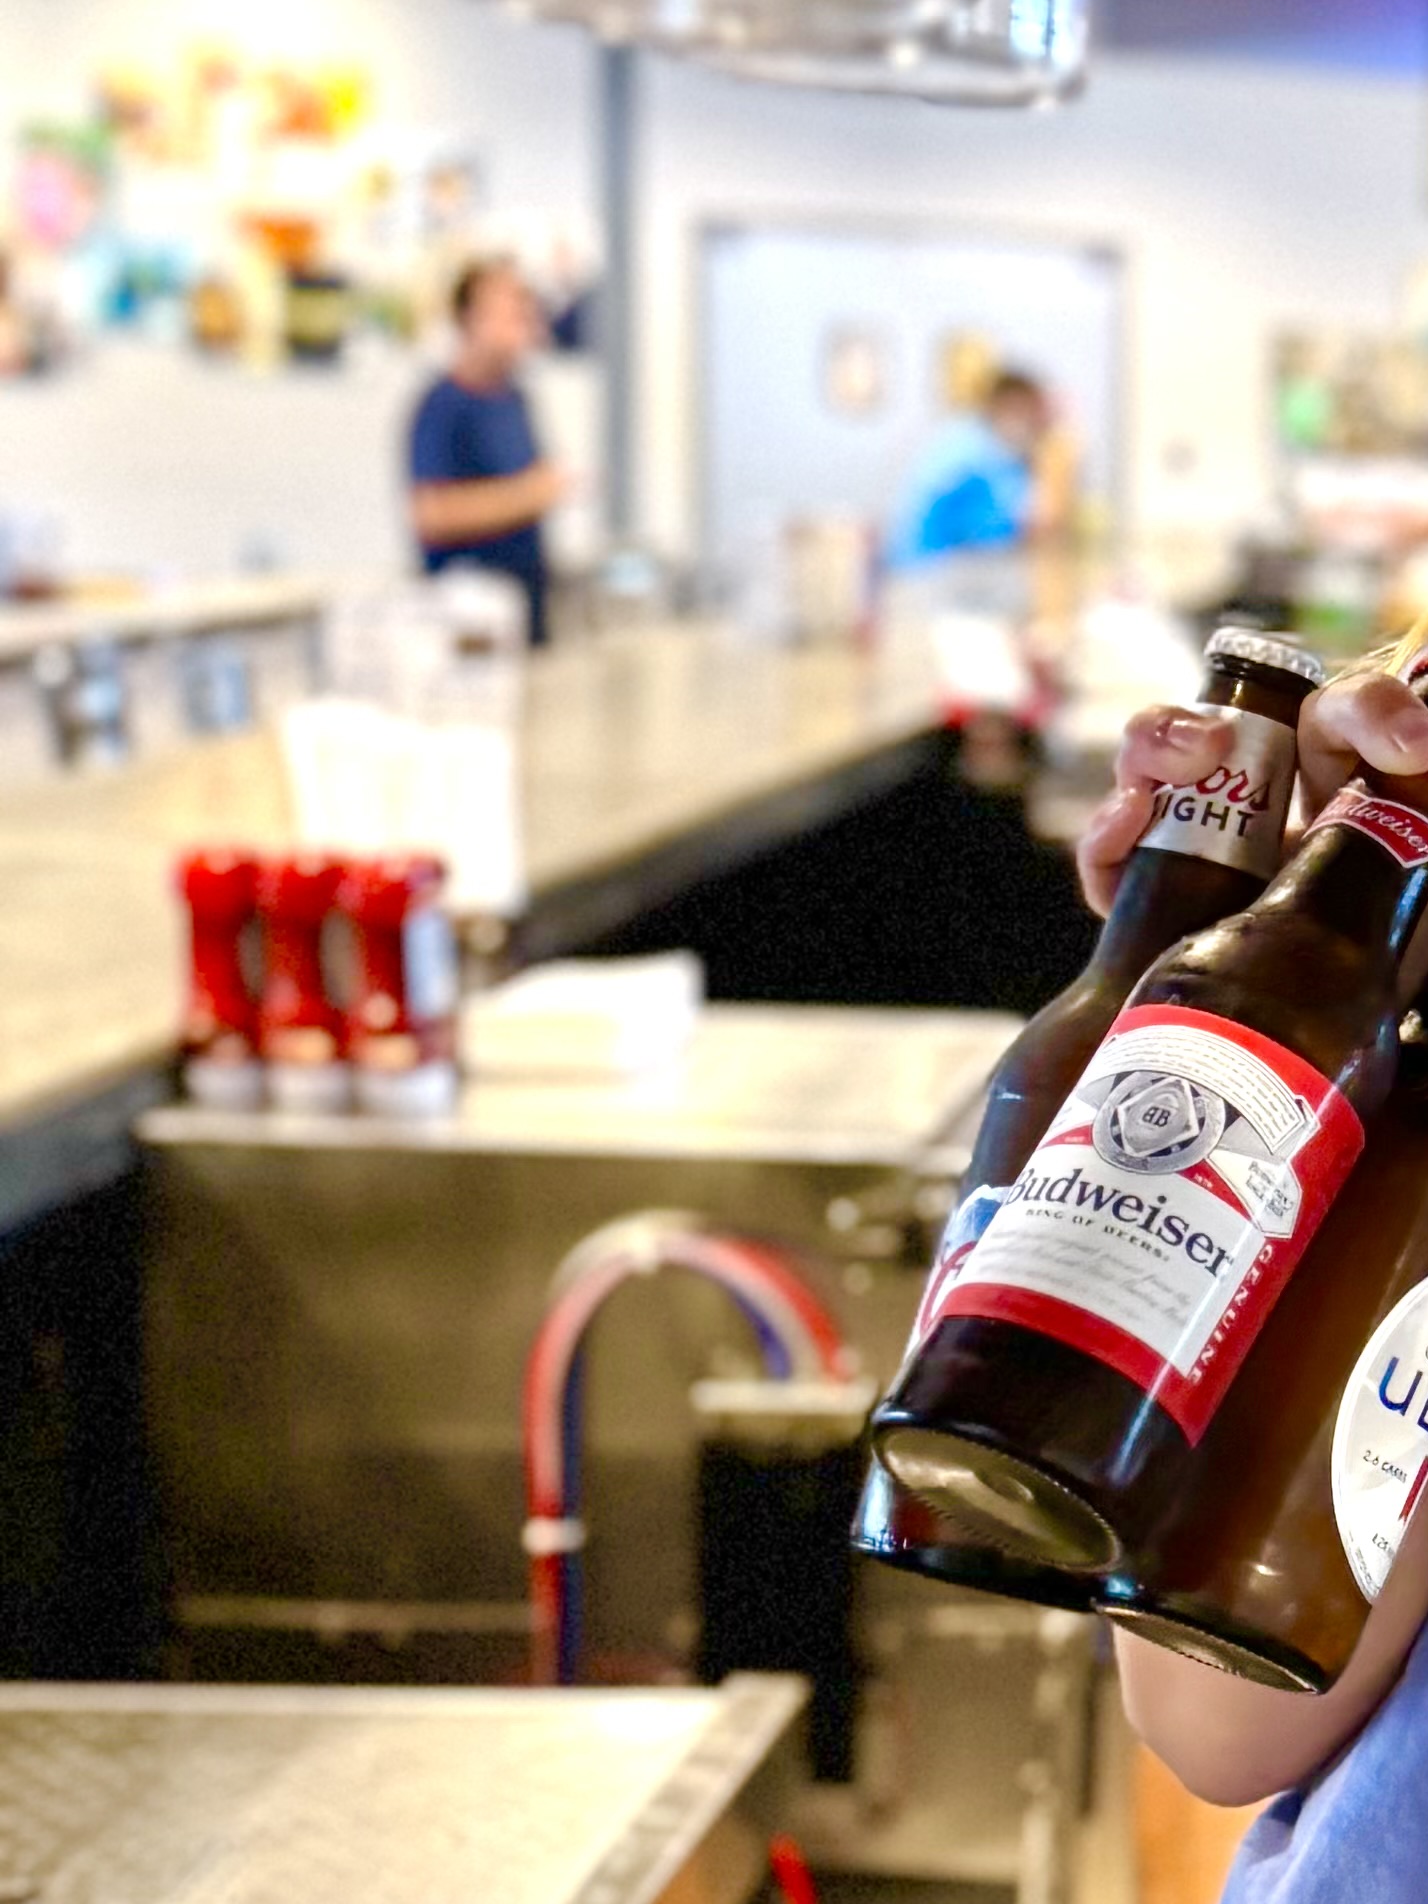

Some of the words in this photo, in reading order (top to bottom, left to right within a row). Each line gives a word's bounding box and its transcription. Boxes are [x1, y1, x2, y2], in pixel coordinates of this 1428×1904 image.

[1005, 1168, 1229, 1278] Budweiser
[1072, 1214, 1096, 1228] OF
[1190, 1244, 1274, 1385] GENUINE
